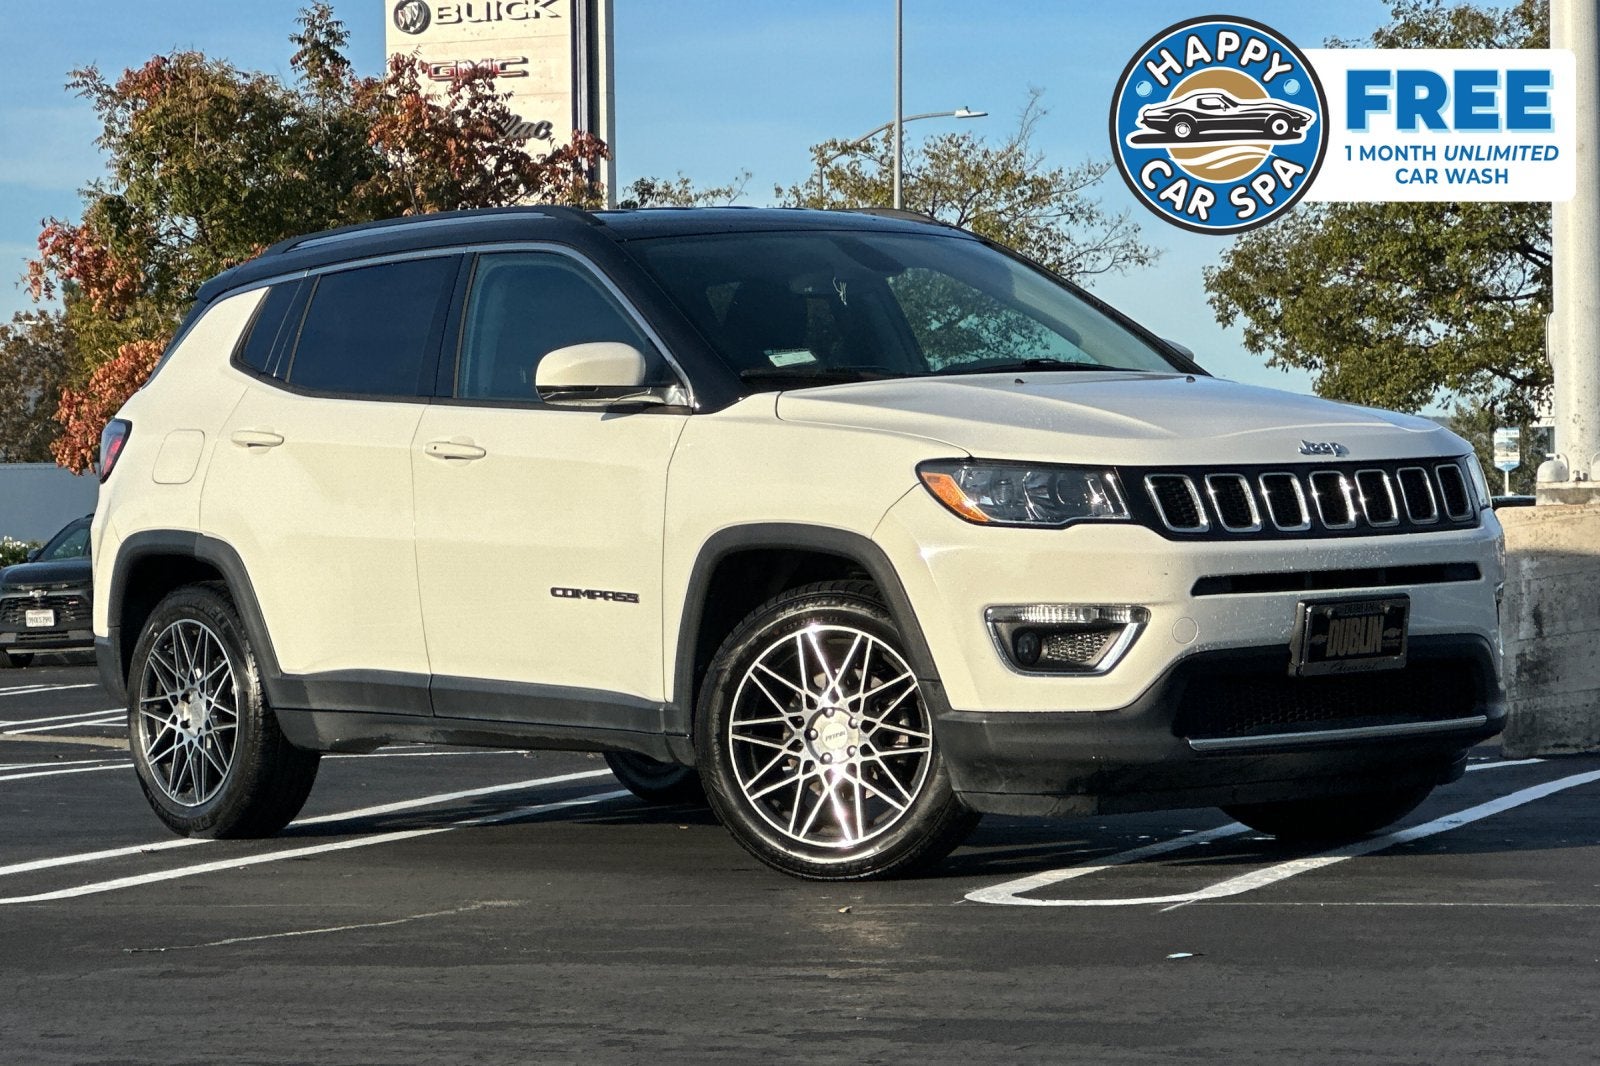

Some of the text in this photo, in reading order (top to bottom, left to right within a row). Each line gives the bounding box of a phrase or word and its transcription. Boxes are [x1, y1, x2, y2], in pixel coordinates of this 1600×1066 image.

[435, 0, 561, 24] BUICK
[1298, 440, 1346, 457] Jeep
[550, 587, 640, 603] COMPASS
[1326, 614, 1385, 657] DUBLIN
